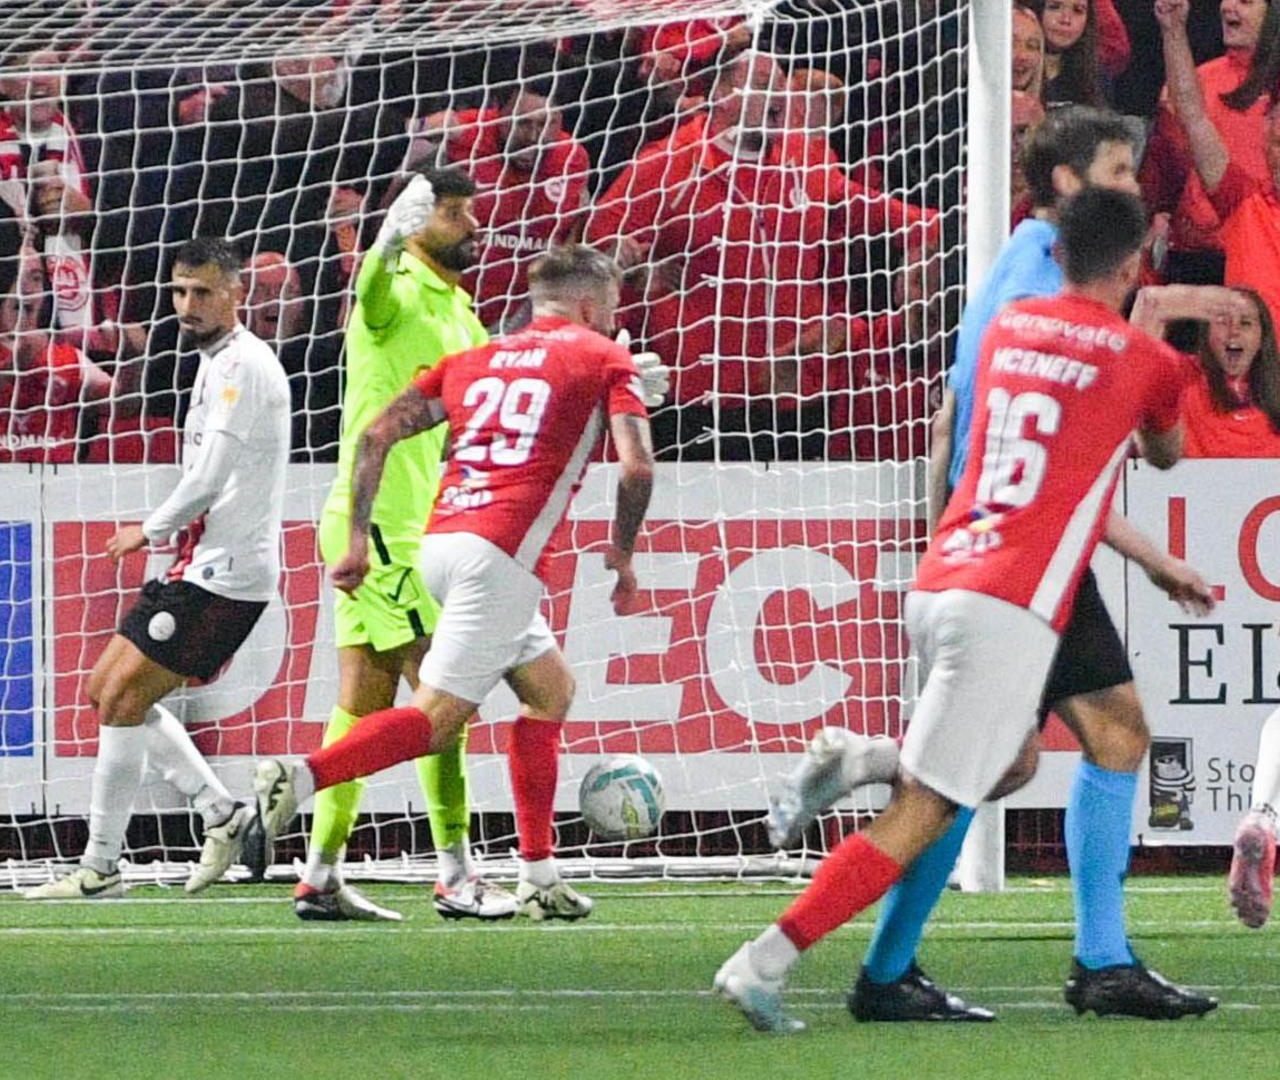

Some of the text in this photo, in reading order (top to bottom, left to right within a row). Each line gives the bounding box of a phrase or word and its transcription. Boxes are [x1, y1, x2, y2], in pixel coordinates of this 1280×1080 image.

[489, 348, 547, 369] RYAN
[455, 376, 551, 465] 29
[976, 387, 1062, 507] 16
[1207, 758, 1254, 784] Sto
